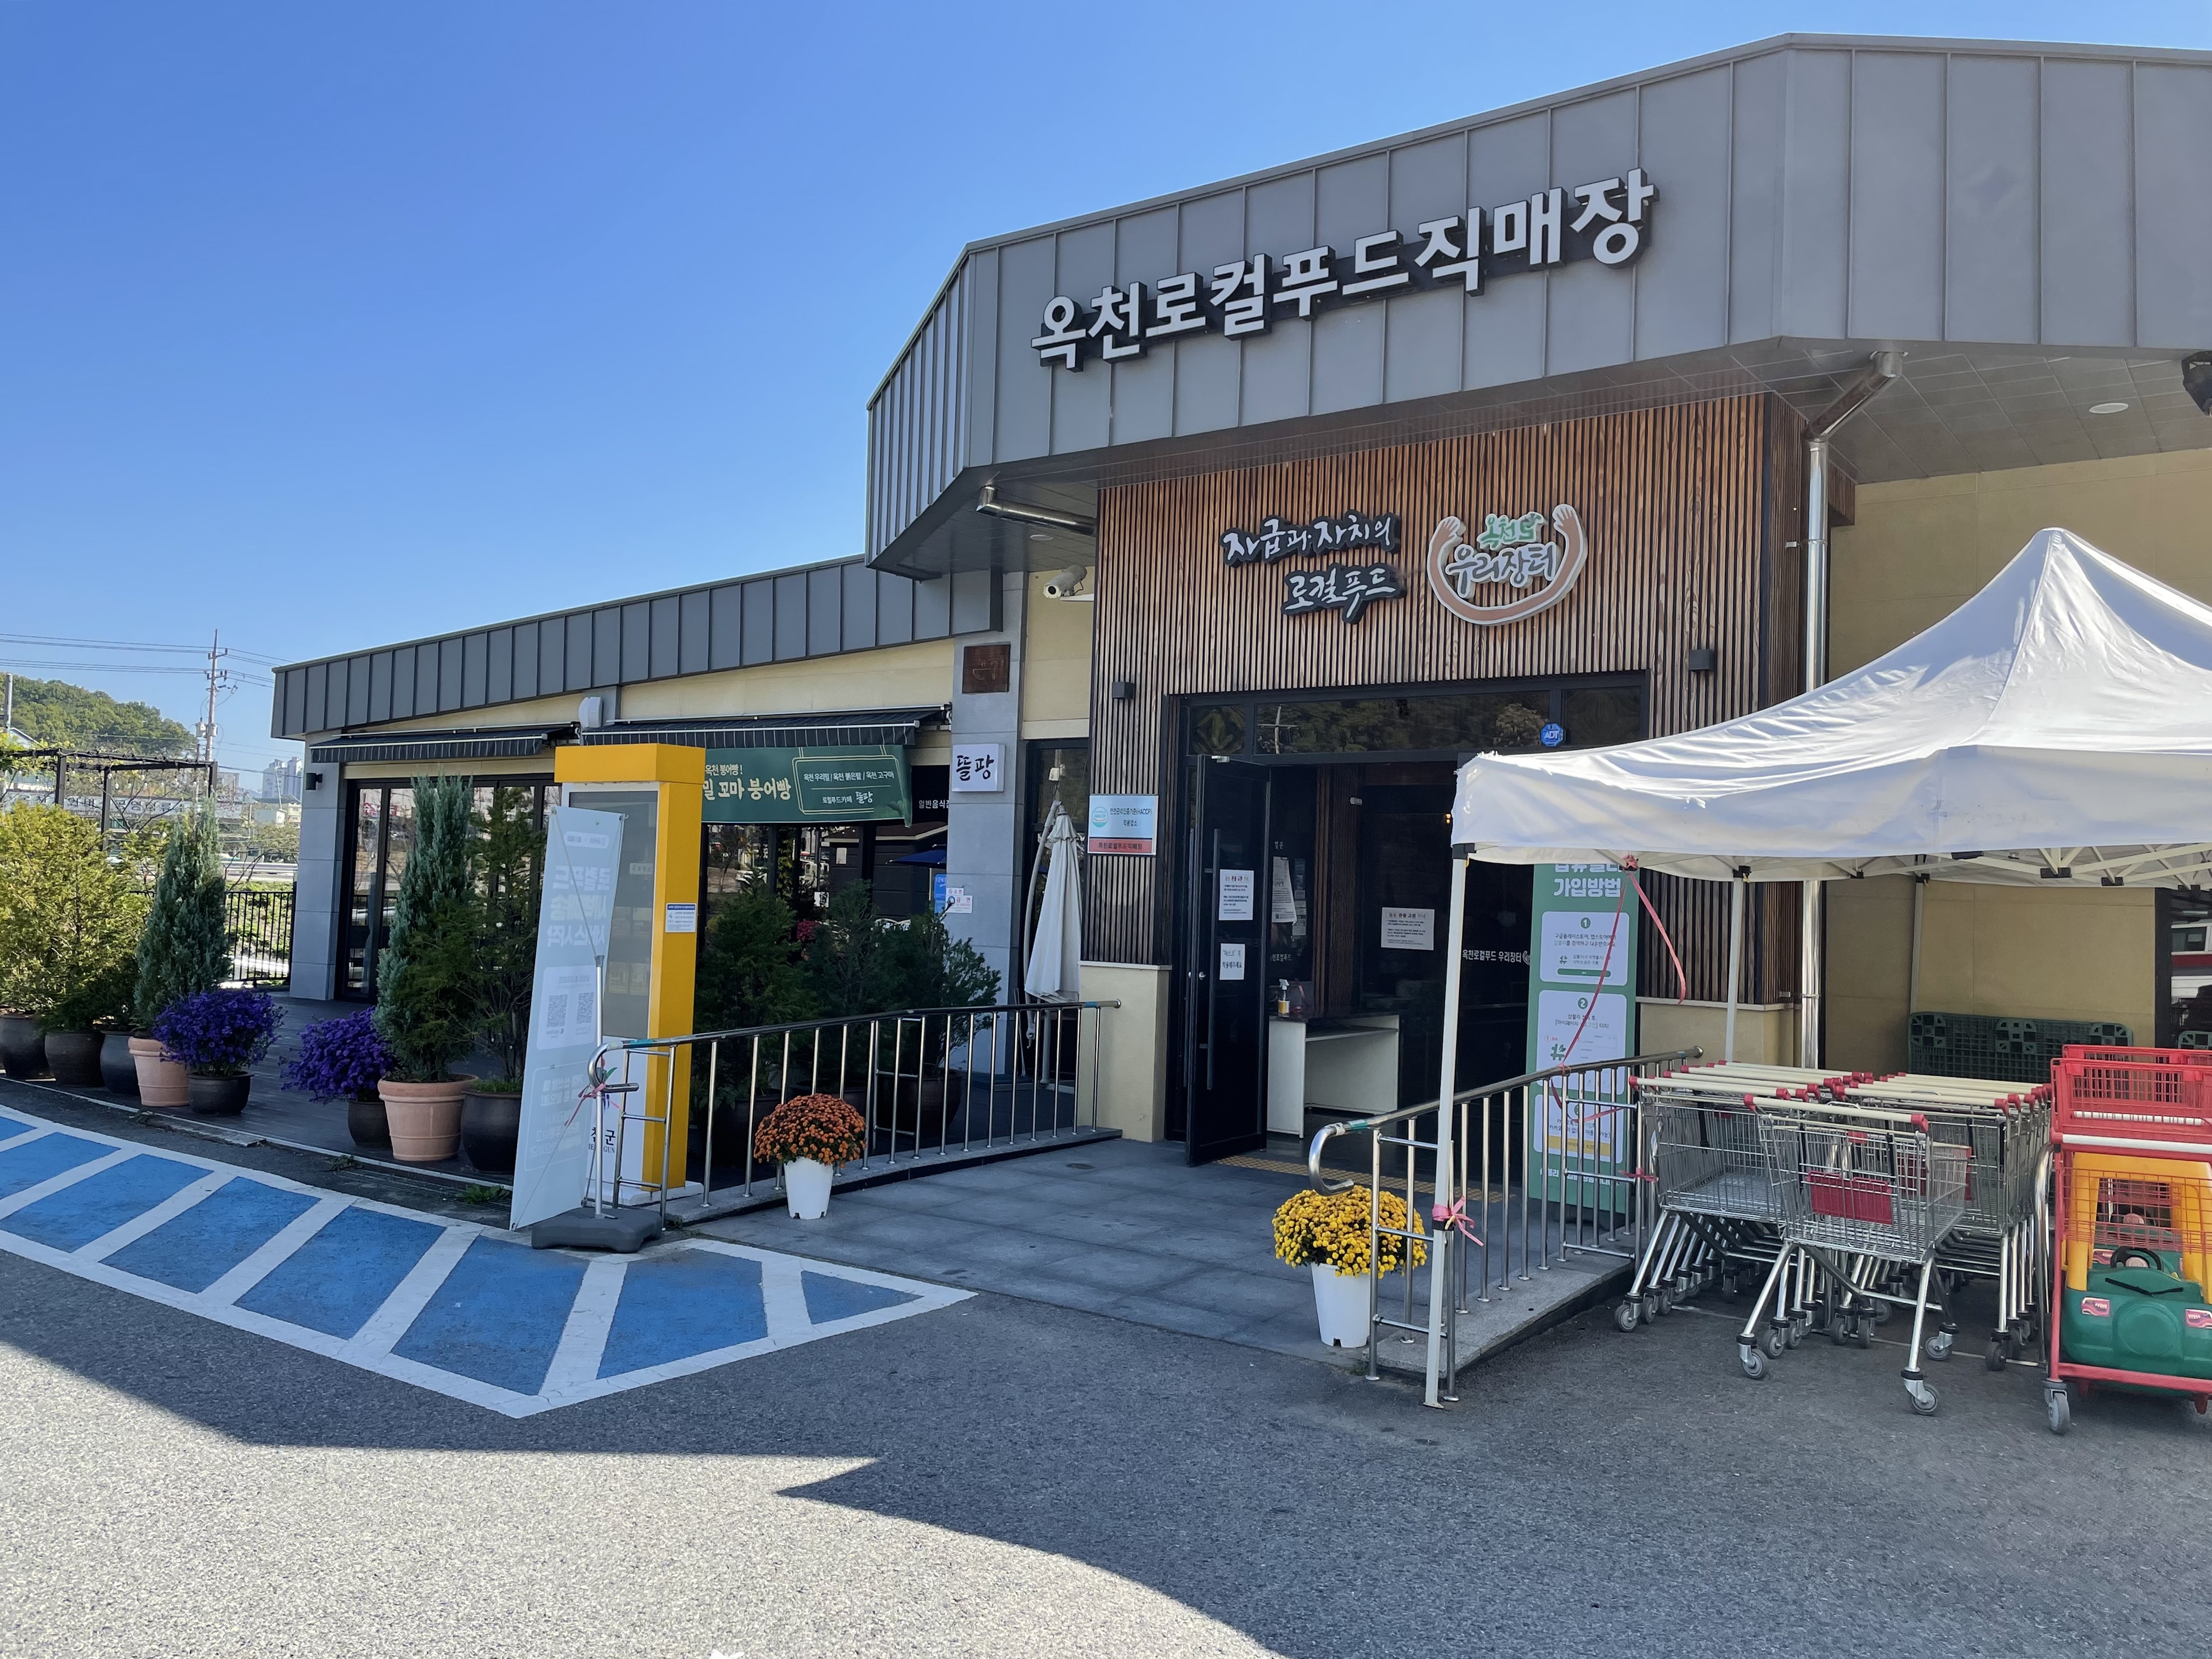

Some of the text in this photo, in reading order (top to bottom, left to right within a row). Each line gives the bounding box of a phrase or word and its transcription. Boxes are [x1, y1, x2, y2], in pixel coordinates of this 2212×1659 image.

[1031, 168, 1658, 371] 옥천로컬푸드직매장
[1224, 515, 1392, 558] 자급과 자치의
[1448, 545, 1556, 595] 우리장터
[1285, 567, 1396, 617] 로컬푸드
[1544, 730, 1559, 739] ADT
[705, 764, 743, 776] 옥천 붕어빵!
[804, 774, 814, 782] 옥천
[815, 773, 830, 781] 우리밀
[833, 772, 844, 781] 옥천
[866, 771, 877, 780] 옥천
[878, 771, 894, 779] 고구마
[956, 754, 994, 781] 뜰팡
[718, 778, 744, 800] 꼬마
[748, 777, 792, 800] 붕어빵
[823, 796, 853, 804] 로컬푸드카페
[1554, 878, 1621, 897] 가입방법
[1463, 950, 1496, 961] 옥천로컬푸드
[1498, 951, 1521, 963] 우리장터
